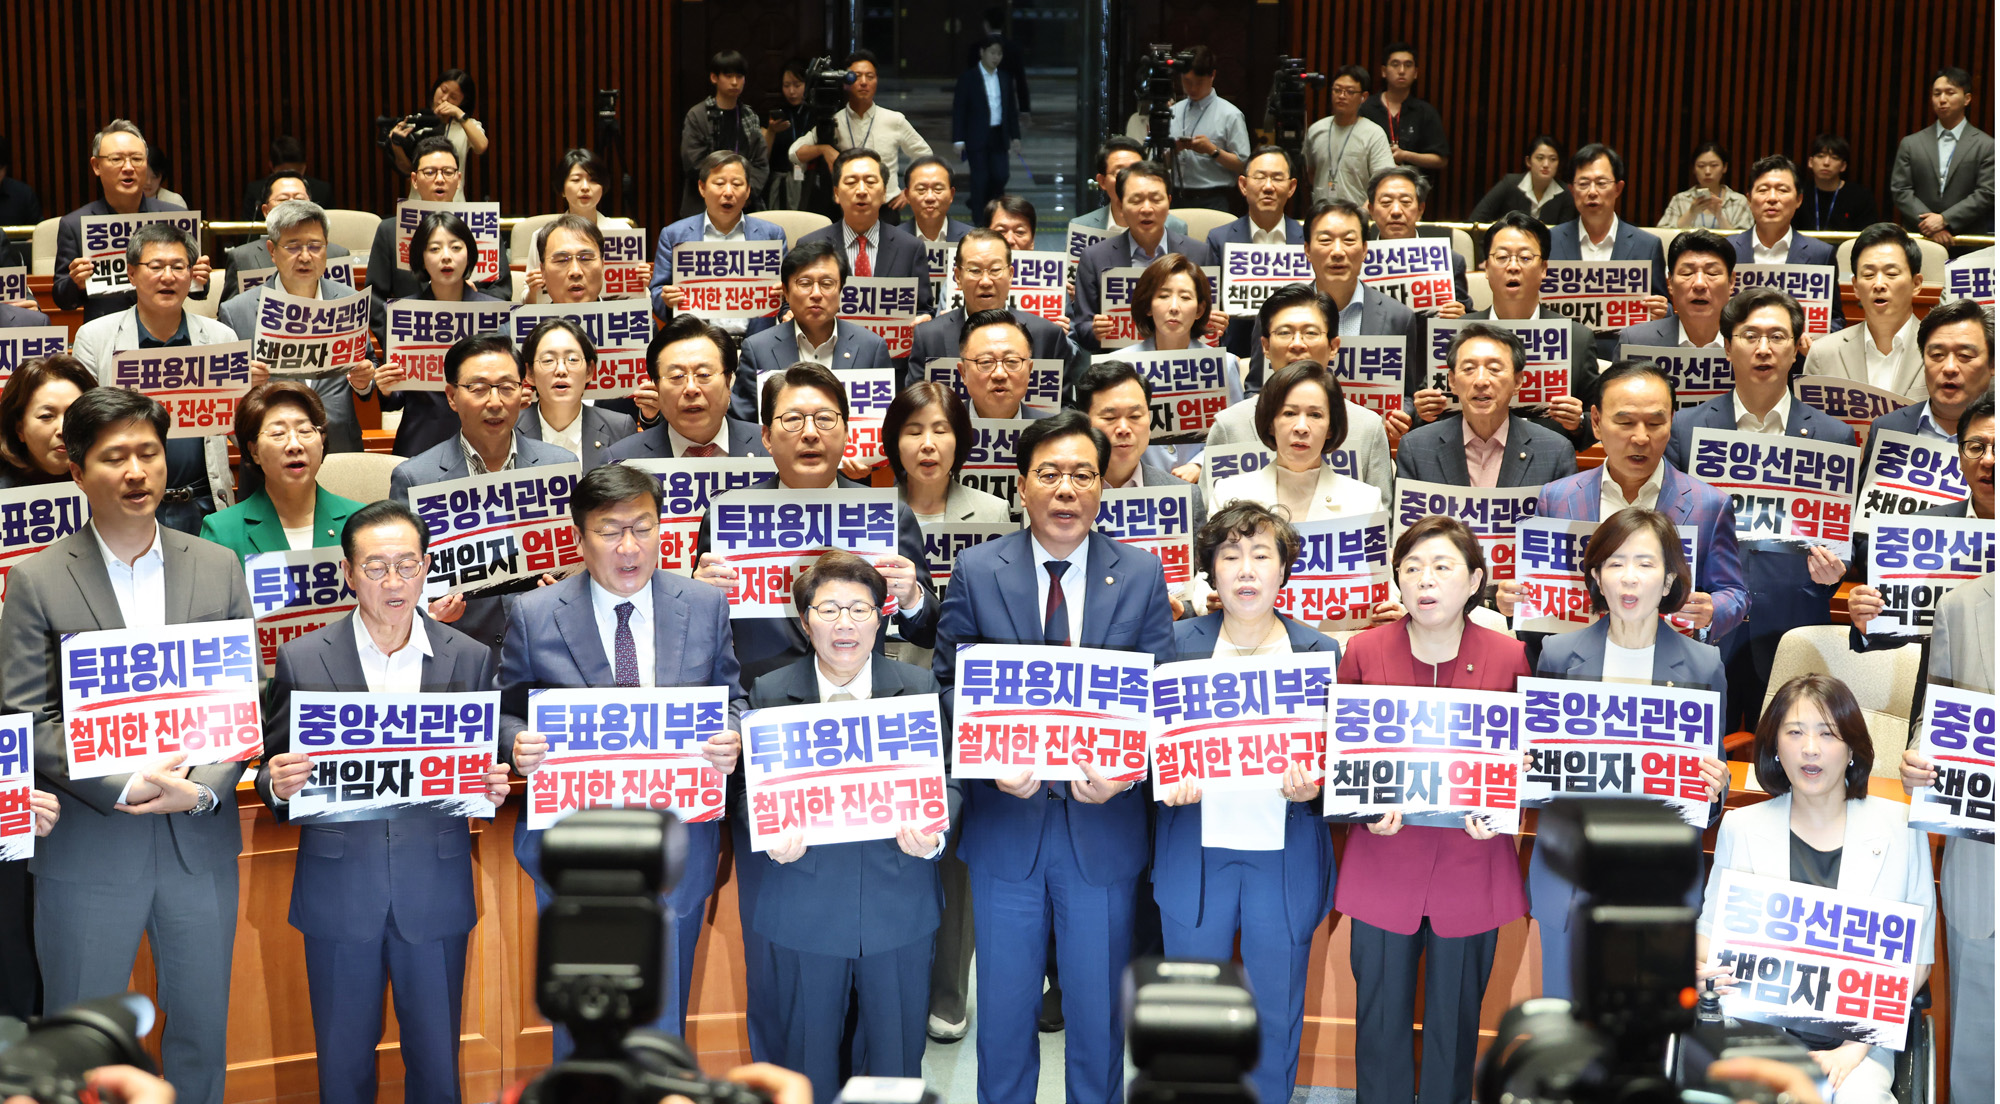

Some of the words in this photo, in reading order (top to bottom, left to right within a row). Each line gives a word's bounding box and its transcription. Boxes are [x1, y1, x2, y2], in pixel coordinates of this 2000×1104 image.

[471, 211, 498, 238] 부족
[605, 268, 644, 293] 엄벌
[677, 250, 745, 277] 투표용지
[748, 249, 780, 275] 부족
[1230, 251, 1311, 277] 중앙선관
[1364, 246, 1449, 276] 앙선관위
[1540, 268, 1648, 293] 중앙선관위
[1951, 267, 1995, 299] 투표
[261, 295, 369, 334] 중앙선관위
[838, 286, 877, 314] 용지
[880, 287, 915, 315] 부족
[1228, 285, 1281, 309] 책임
[1411, 278, 1453, 308] 엄벌
[391, 309, 474, 343] 투표용지
[608, 310, 650, 346] 부족
[1802, 306, 1829, 333] 벌
[116, 356, 205, 389] 투표용지
[208, 351, 249, 386] 부족
[256, 338, 328, 369] 책임자
[331, 331, 367, 366] 엄벌
[1359, 347, 1402, 380] 부족
[850, 380, 892, 414] 부족
[1518, 369, 1568, 403] 엄벌
[178, 398, 240, 427] 진상규
[1696, 439, 1855, 494] 중앙선관위
[1875, 440, 1968, 496] 중앙선
[0, 496, 82, 546] 표용지
[417, 474, 577, 536] 중앙선관위
[717, 503, 832, 549] 투표용지
[838, 502, 895, 547] 부족
[1095, 497, 1188, 537] 선관위
[1730, 493, 1786, 534] 임자
[1791, 498, 1851, 542] 엄벌
[427, 536, 519, 587] 책임자
[522, 526, 584, 571] 엄벌
[1338, 525, 1387, 571] 부족
[1491, 543, 1515, 580] 엄
[1522, 529, 1591, 571] 투표
[1875, 527, 1995, 573] 중앙선
[1301, 581, 1389, 620] 진상규명
[1875, 583, 1952, 626] 책임
[69, 640, 187, 698] 투표용지
[192, 634, 253, 686] 부족
[961, 659, 1083, 708] 투표용지
[1088, 664, 1149, 713] 부족
[1153, 670, 1270, 724] 투표용지
[1274, 667, 1331, 713] 부족
[1524, 689, 1713, 745] 중앙선관위
[69, 712, 149, 763] 철저한
[154, 701, 260, 754] 진상규명
[298, 703, 494, 746] 중앙선관위
[537, 703, 658, 752] 투표용지
[665, 701, 724, 750] 부족
[750, 716, 873, 773] 투표용지
[878, 710, 938, 761] 부족
[957, 722, 1040, 766] 철저한
[1045, 725, 1147, 769] 진상규명
[1335, 697, 1519, 751] 중앙선관위
[300, 759, 414, 802] 책임자
[420, 752, 493, 796] 엄벌
[1156, 737, 1232, 785] 철저한
[1526, 748, 1635, 793] 책임자
[1641, 751, 1709, 802] 엄벌
[533, 769, 615, 814] 철저한
[622, 767, 724, 808] 진상규명
[753, 786, 834, 835] 철저한
[841, 776, 946, 827] 진상규명
[1333, 759, 1442, 805] 책임자
[1448, 760, 1517, 810] 엄벌
[1723, 884, 1916, 964] 중앙선관위
[1718, 949, 1831, 1012] 책임자
[1836, 968, 1910, 1025] 엄벌
